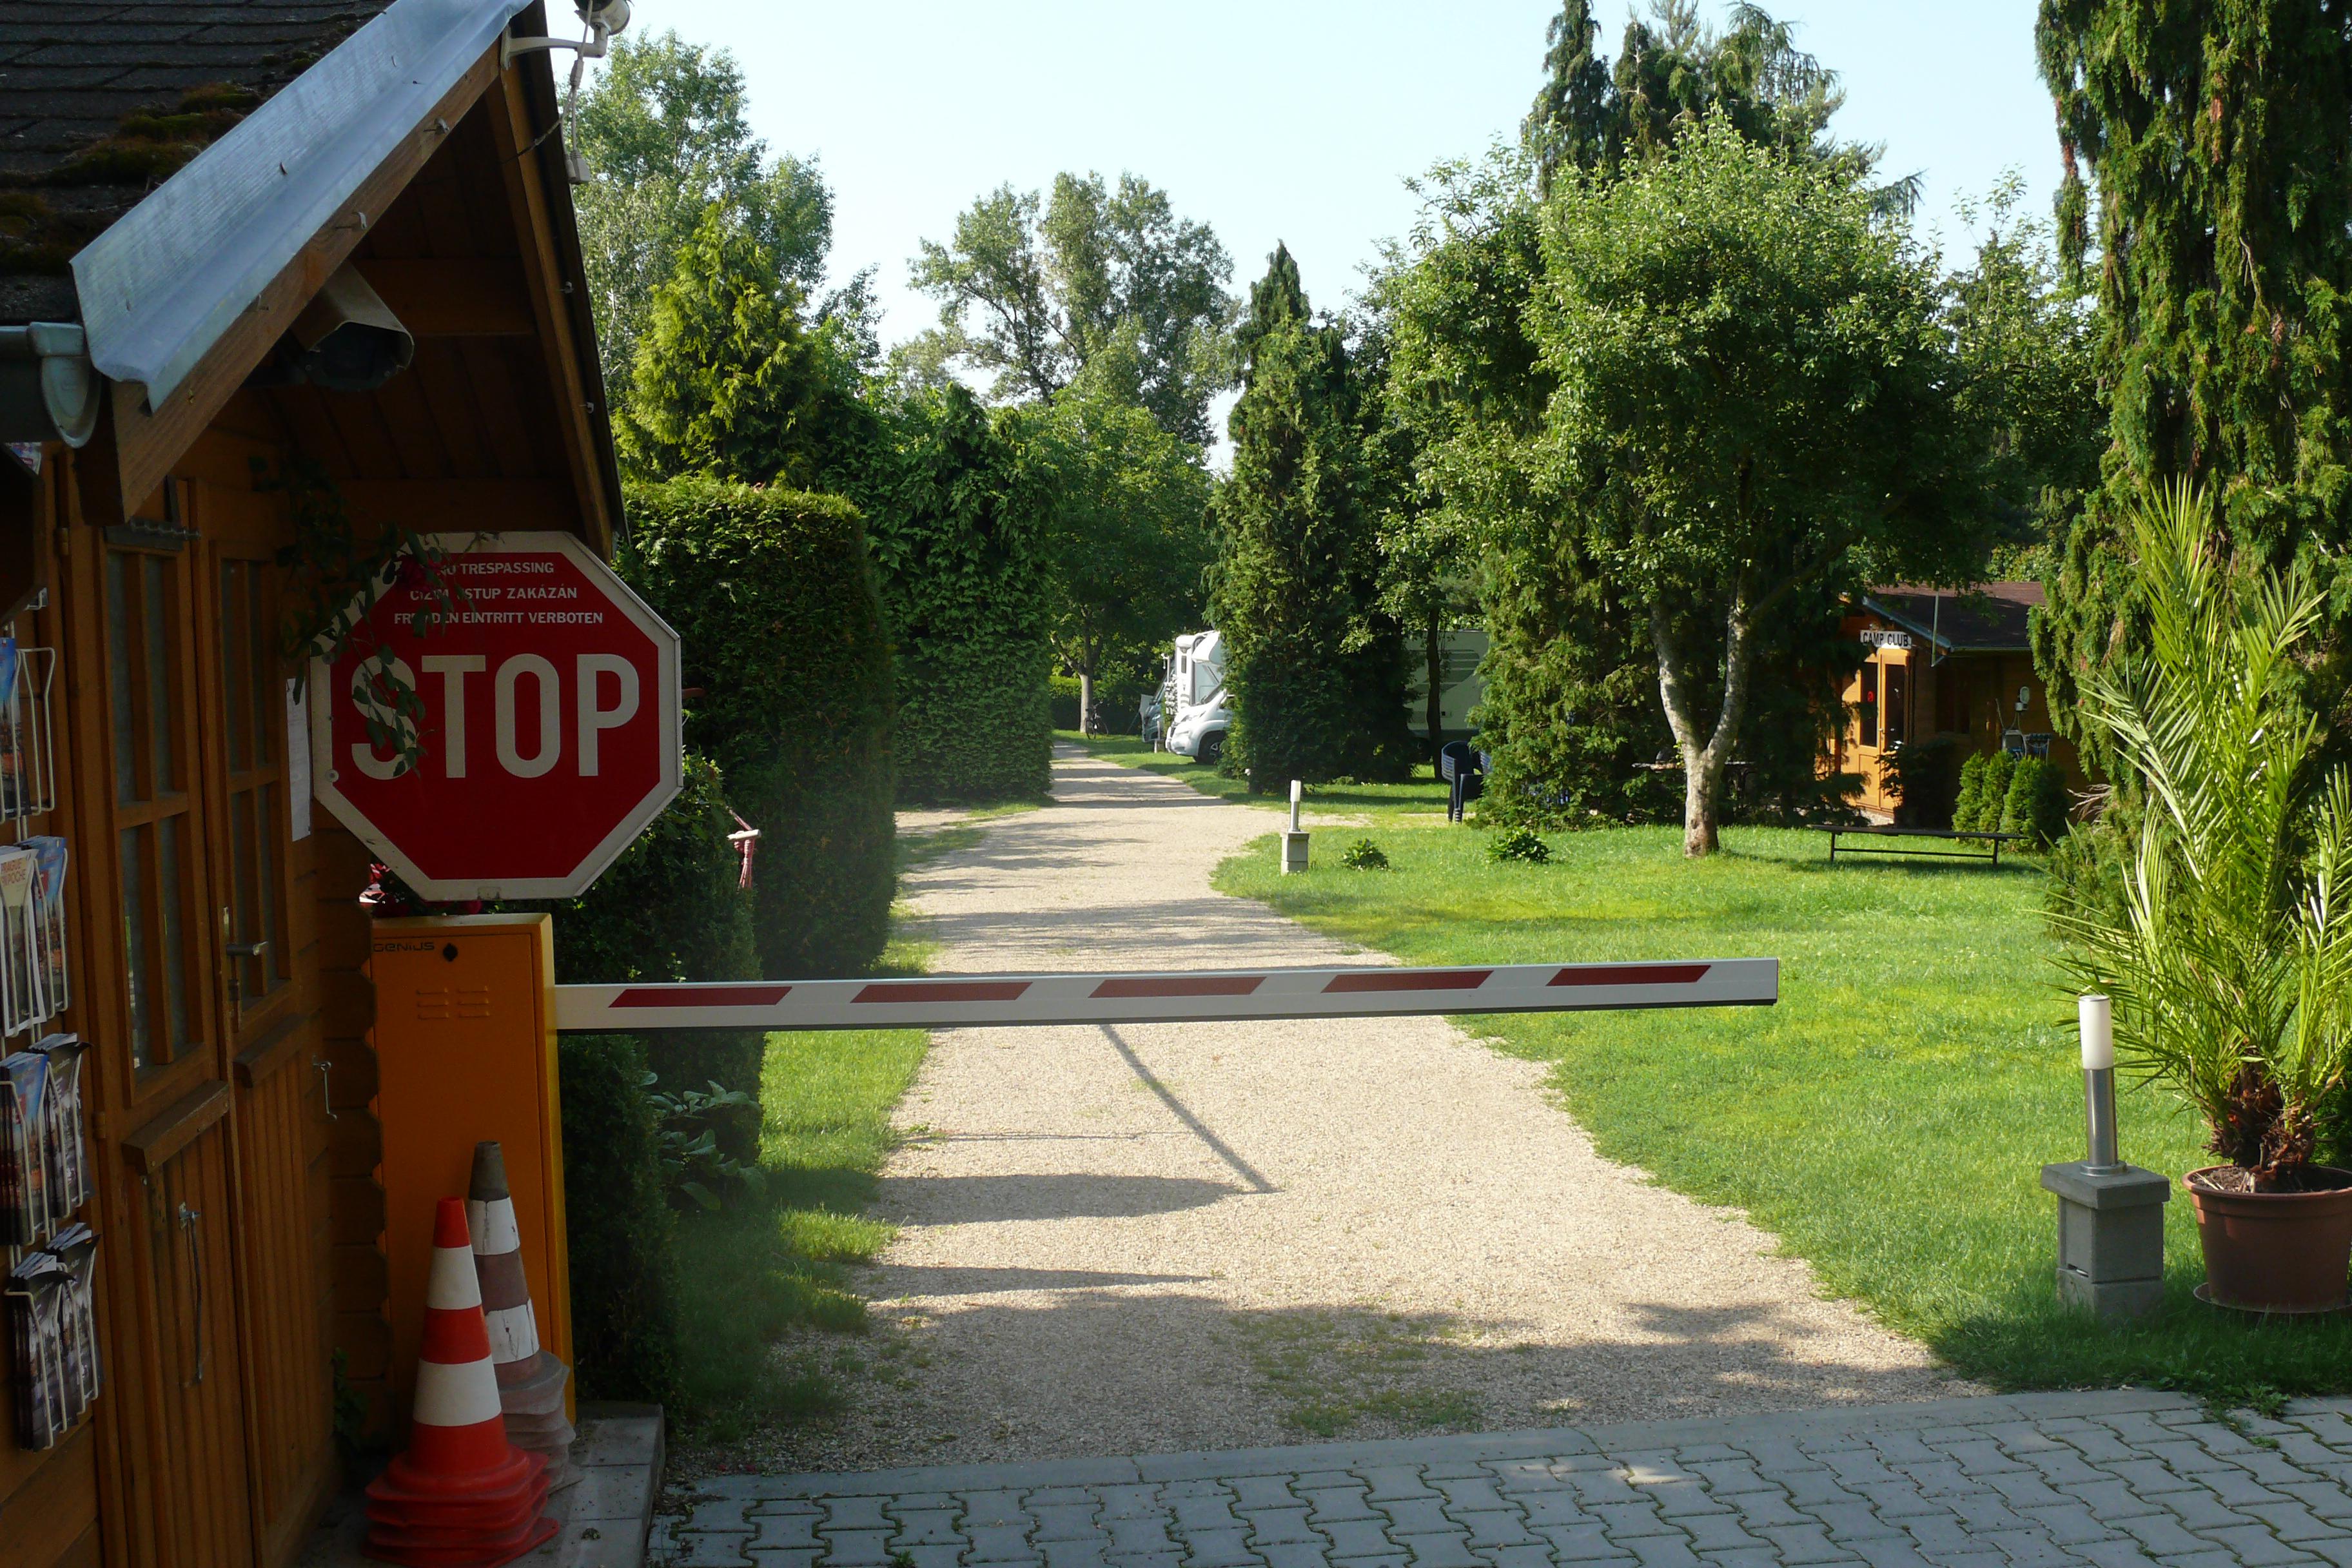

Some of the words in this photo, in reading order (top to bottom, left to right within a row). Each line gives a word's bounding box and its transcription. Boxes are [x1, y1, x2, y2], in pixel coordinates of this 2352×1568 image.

[460, 562, 554, 575] TRESPASSING
[455, 587, 501, 600] STUP
[506, 583, 577, 599] ZAKÁZÁN
[462, 612, 524, 624] EINTRITT
[528, 612, 603, 624] VERBOTEN
[1863, 632, 1884, 645] CAMP
[1887, 633, 1908, 647] CLUB
[351, 653, 640, 780] STOP
